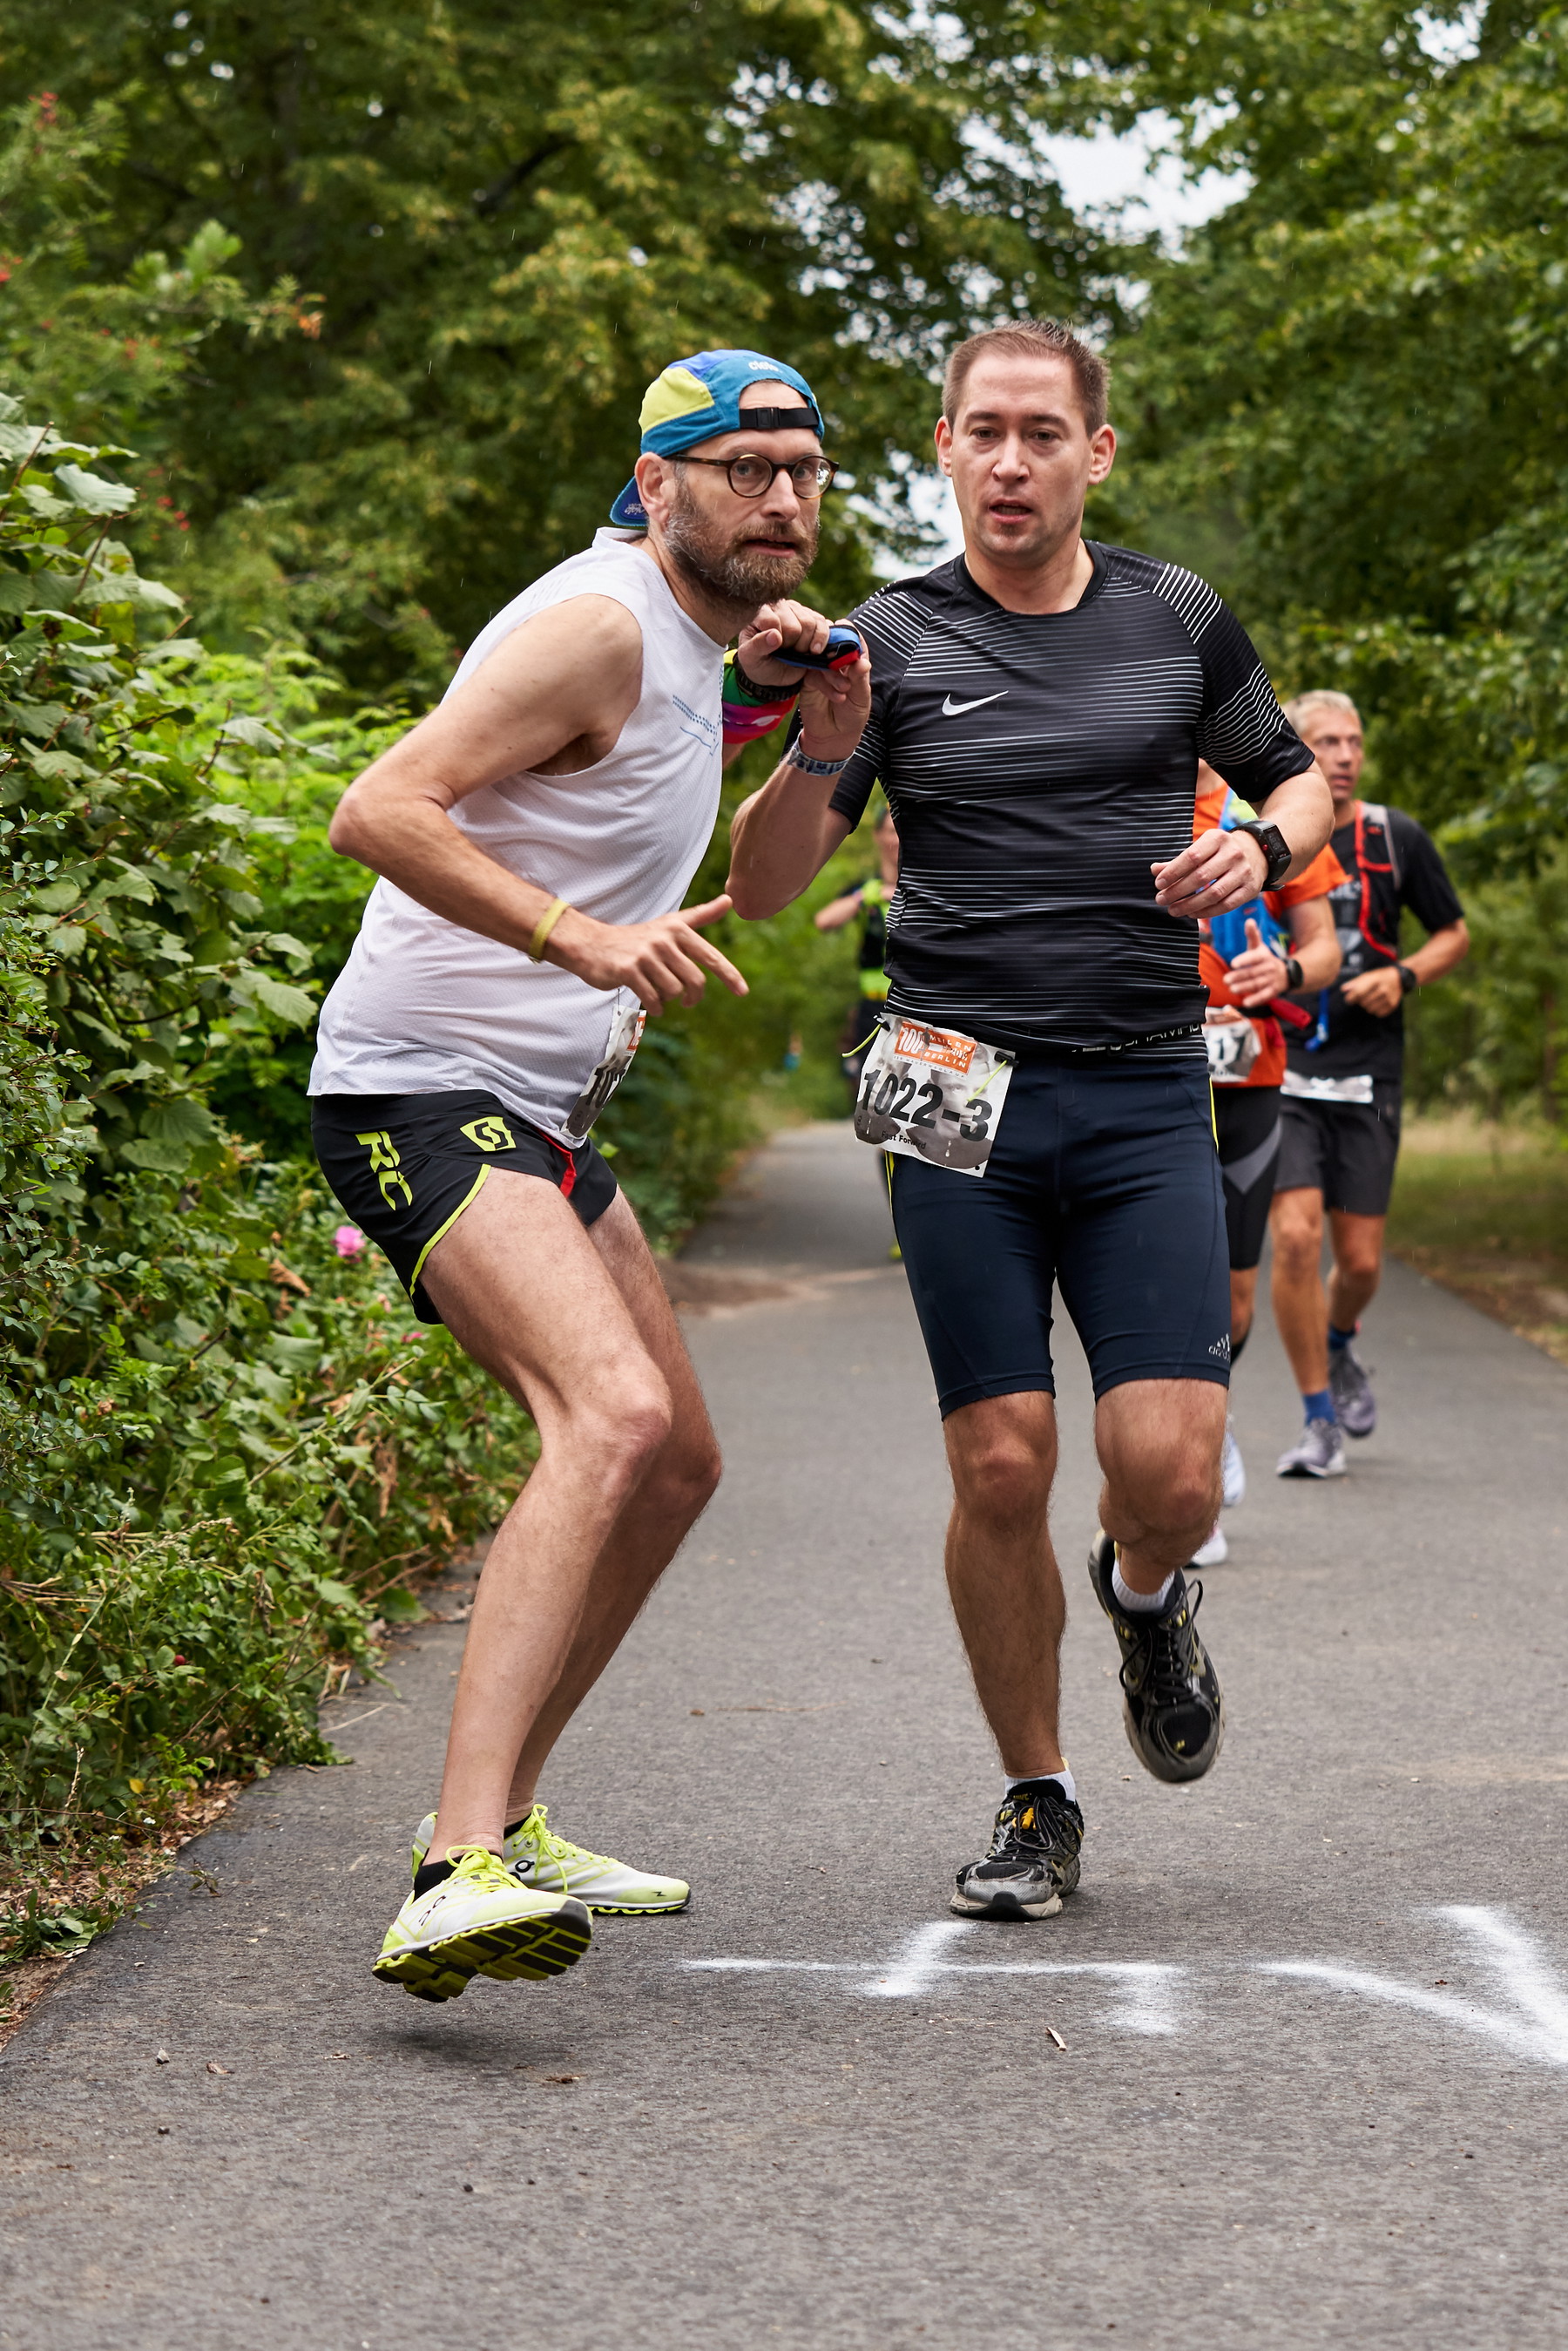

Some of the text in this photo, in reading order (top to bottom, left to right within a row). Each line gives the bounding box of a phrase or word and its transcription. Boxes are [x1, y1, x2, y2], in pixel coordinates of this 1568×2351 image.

[929, 1034, 972, 1052] MEILEN
[923, 1051, 966, 1068] BERLIN
[862, 1068, 993, 1142] 1022-3
[881, 1130, 927, 1149] Fast Forward
